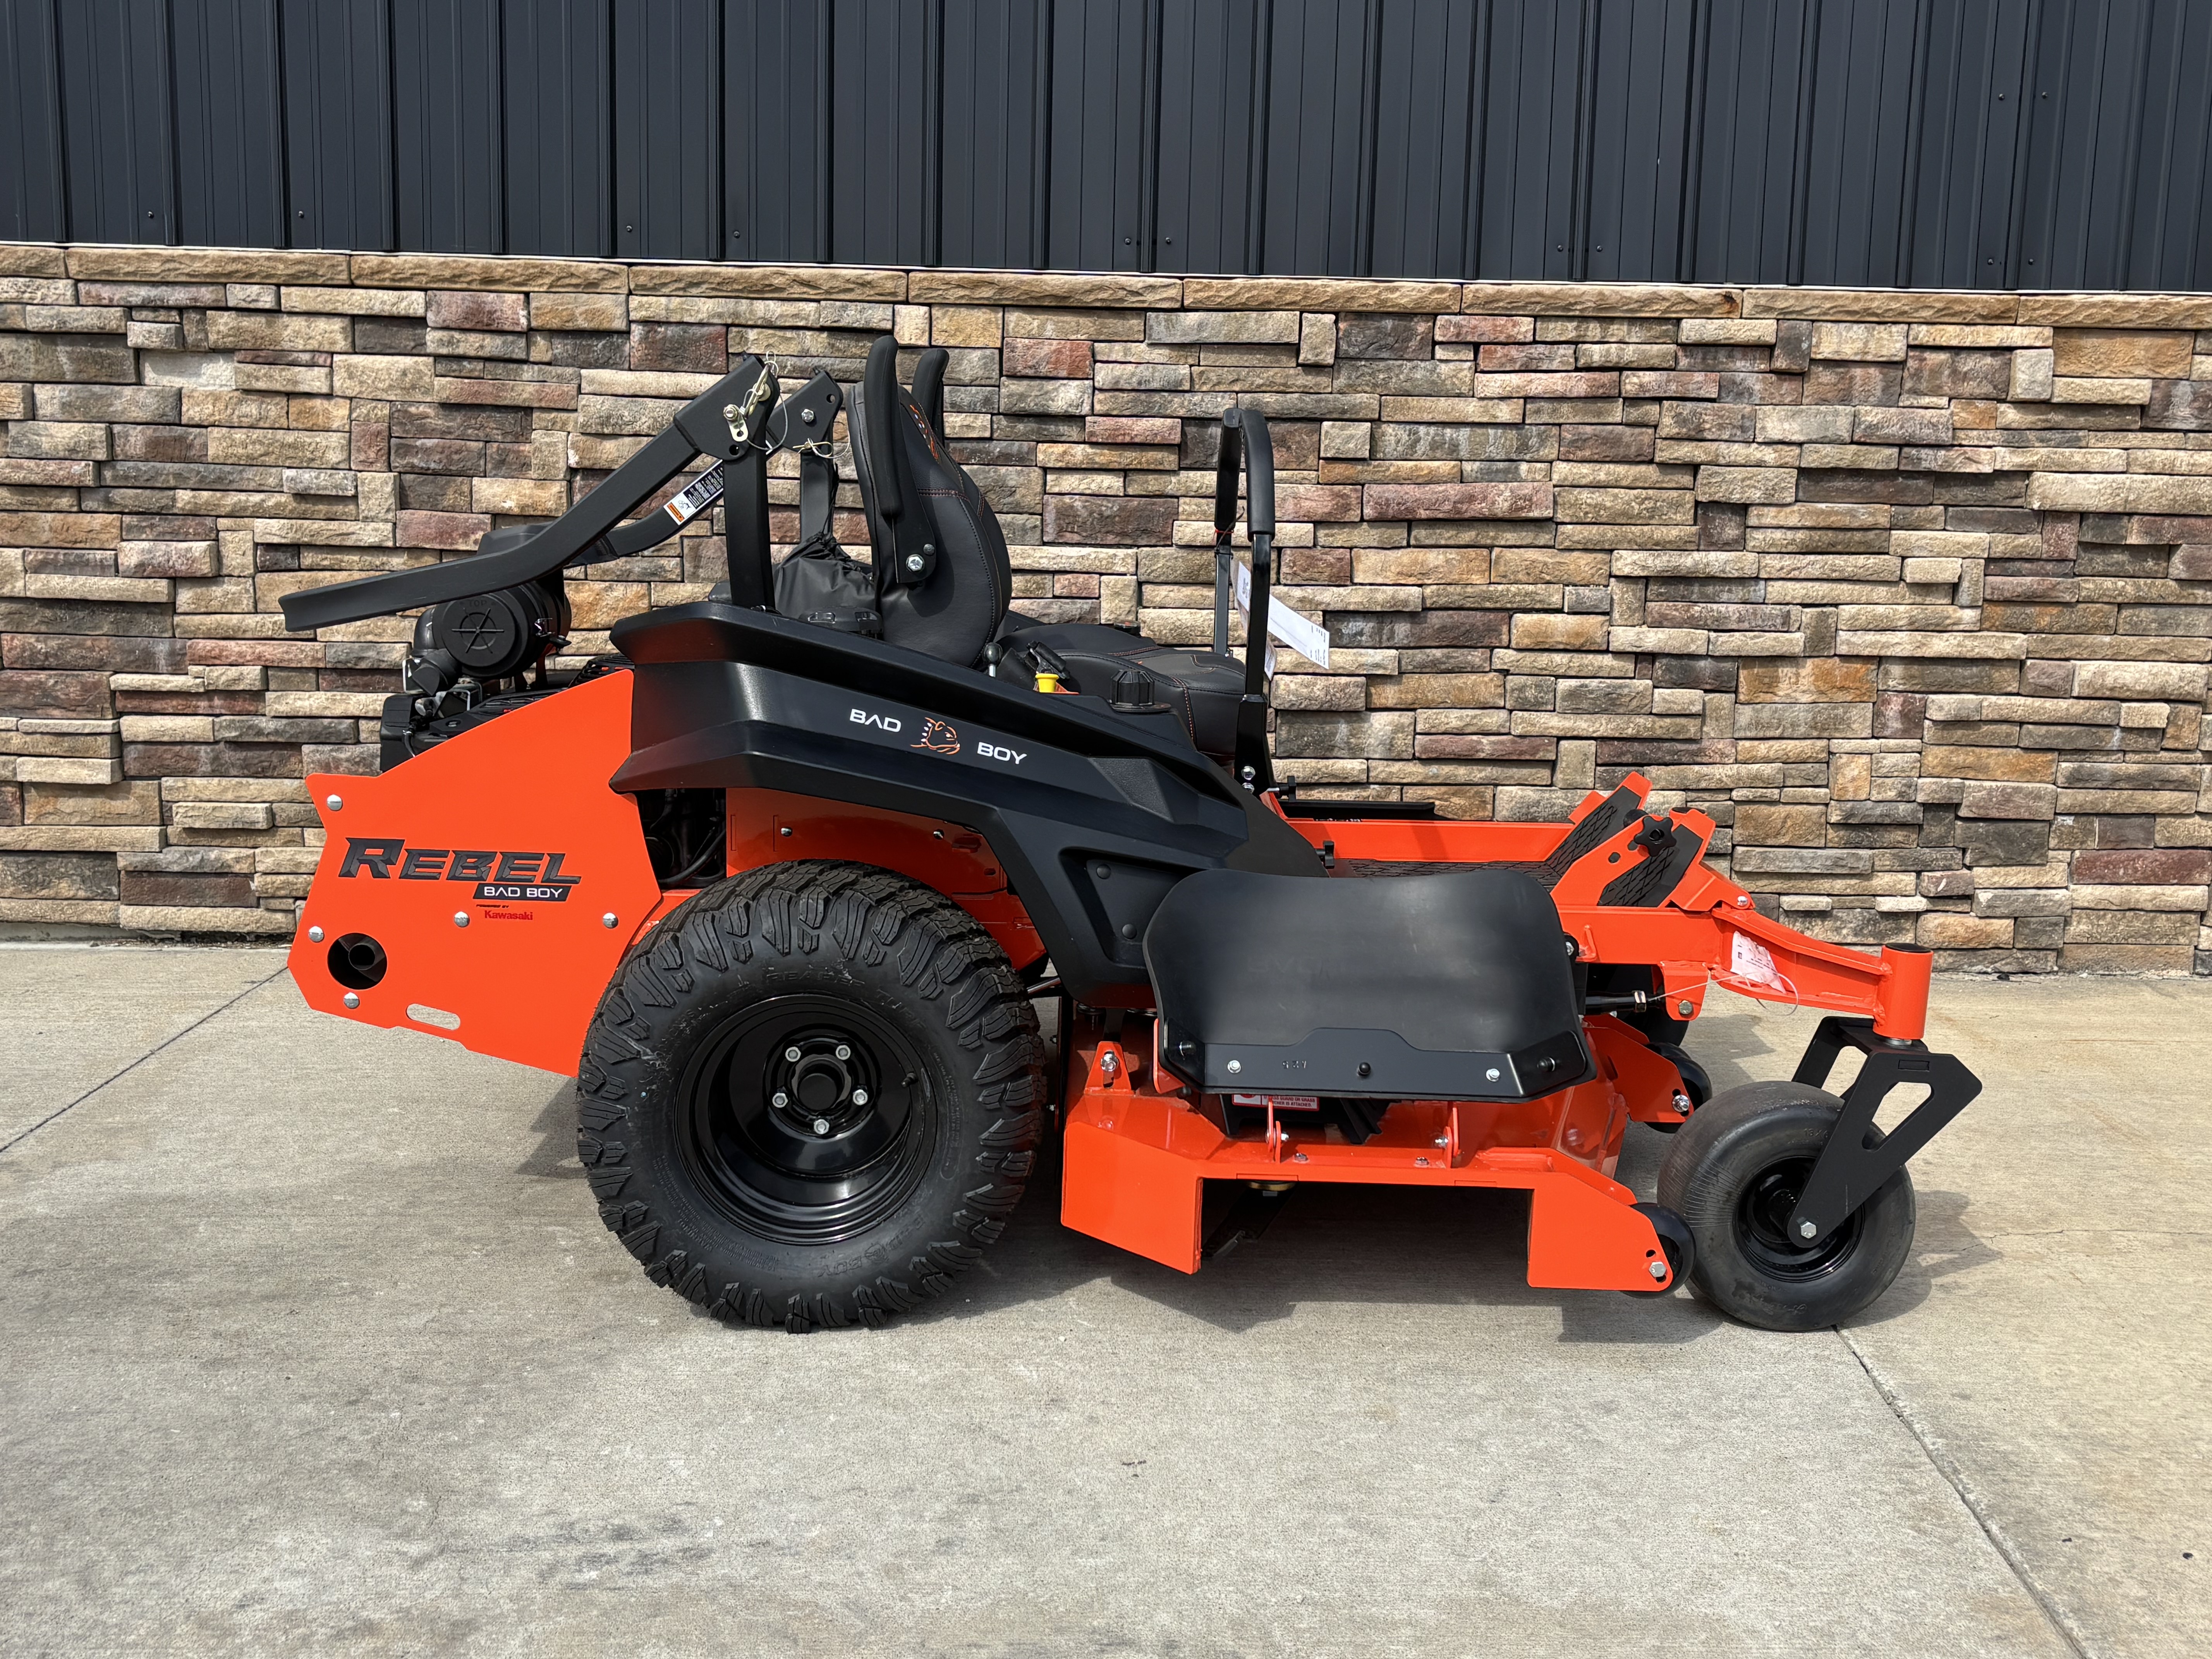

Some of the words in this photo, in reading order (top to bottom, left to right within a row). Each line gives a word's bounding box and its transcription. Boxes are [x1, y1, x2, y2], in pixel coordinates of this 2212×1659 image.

[850, 708, 901, 732] BAD
[977, 741, 1027, 764] BOY
[338, 837, 582, 884] REBEL
[484, 886, 520, 897] BAD
[526, 887, 563, 898] BOY
[484, 910, 533, 921] Kawasaki
